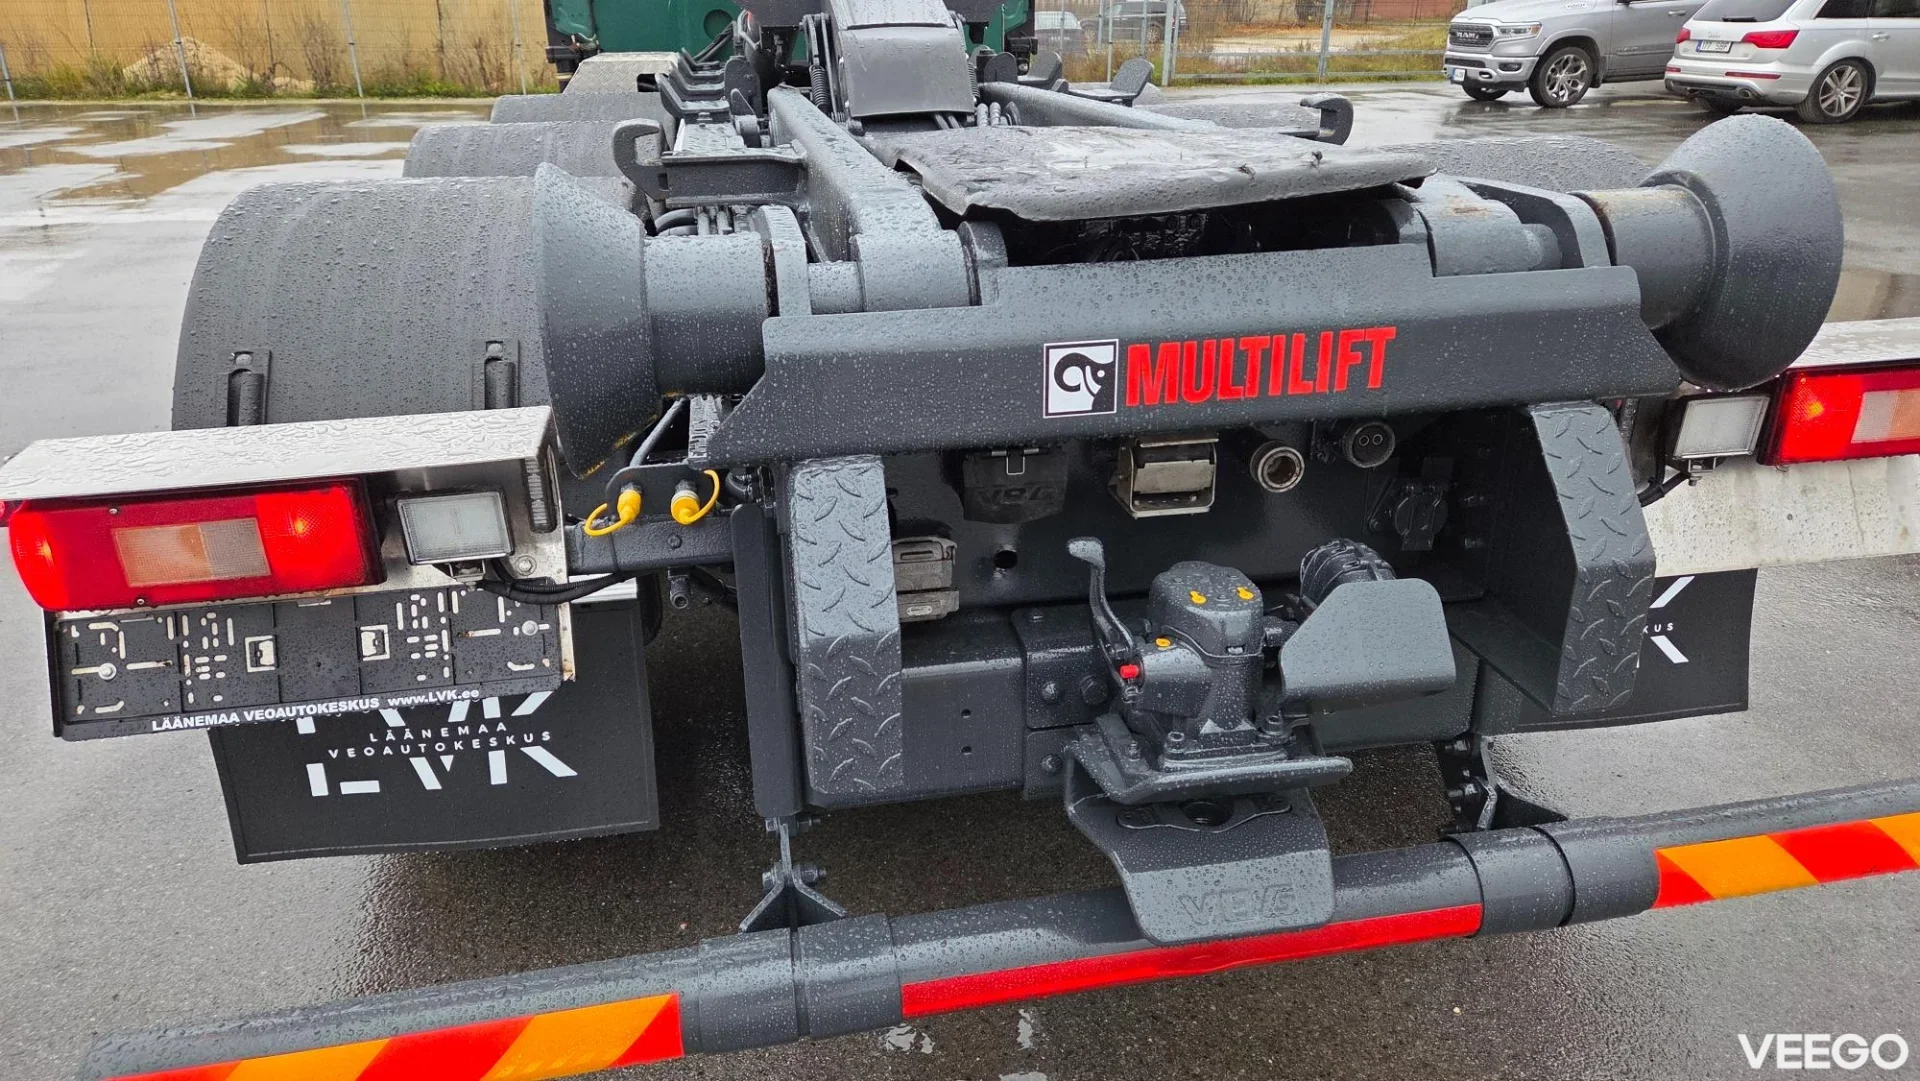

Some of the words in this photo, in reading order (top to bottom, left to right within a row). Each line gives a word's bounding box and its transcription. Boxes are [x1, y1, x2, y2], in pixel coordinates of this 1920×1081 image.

[1126, 326, 1397, 407] MULTILIFT
[152, 712, 241, 732] LÄÄNEMAA
[244, 697, 380, 722] VEOAUTOKESKUS
[387, 688, 480, 708] www.LVK.ee
[328, 731, 551, 759] VEOAUTOKESKUS
[369, 722, 507, 743] LÄÄNEMAA
